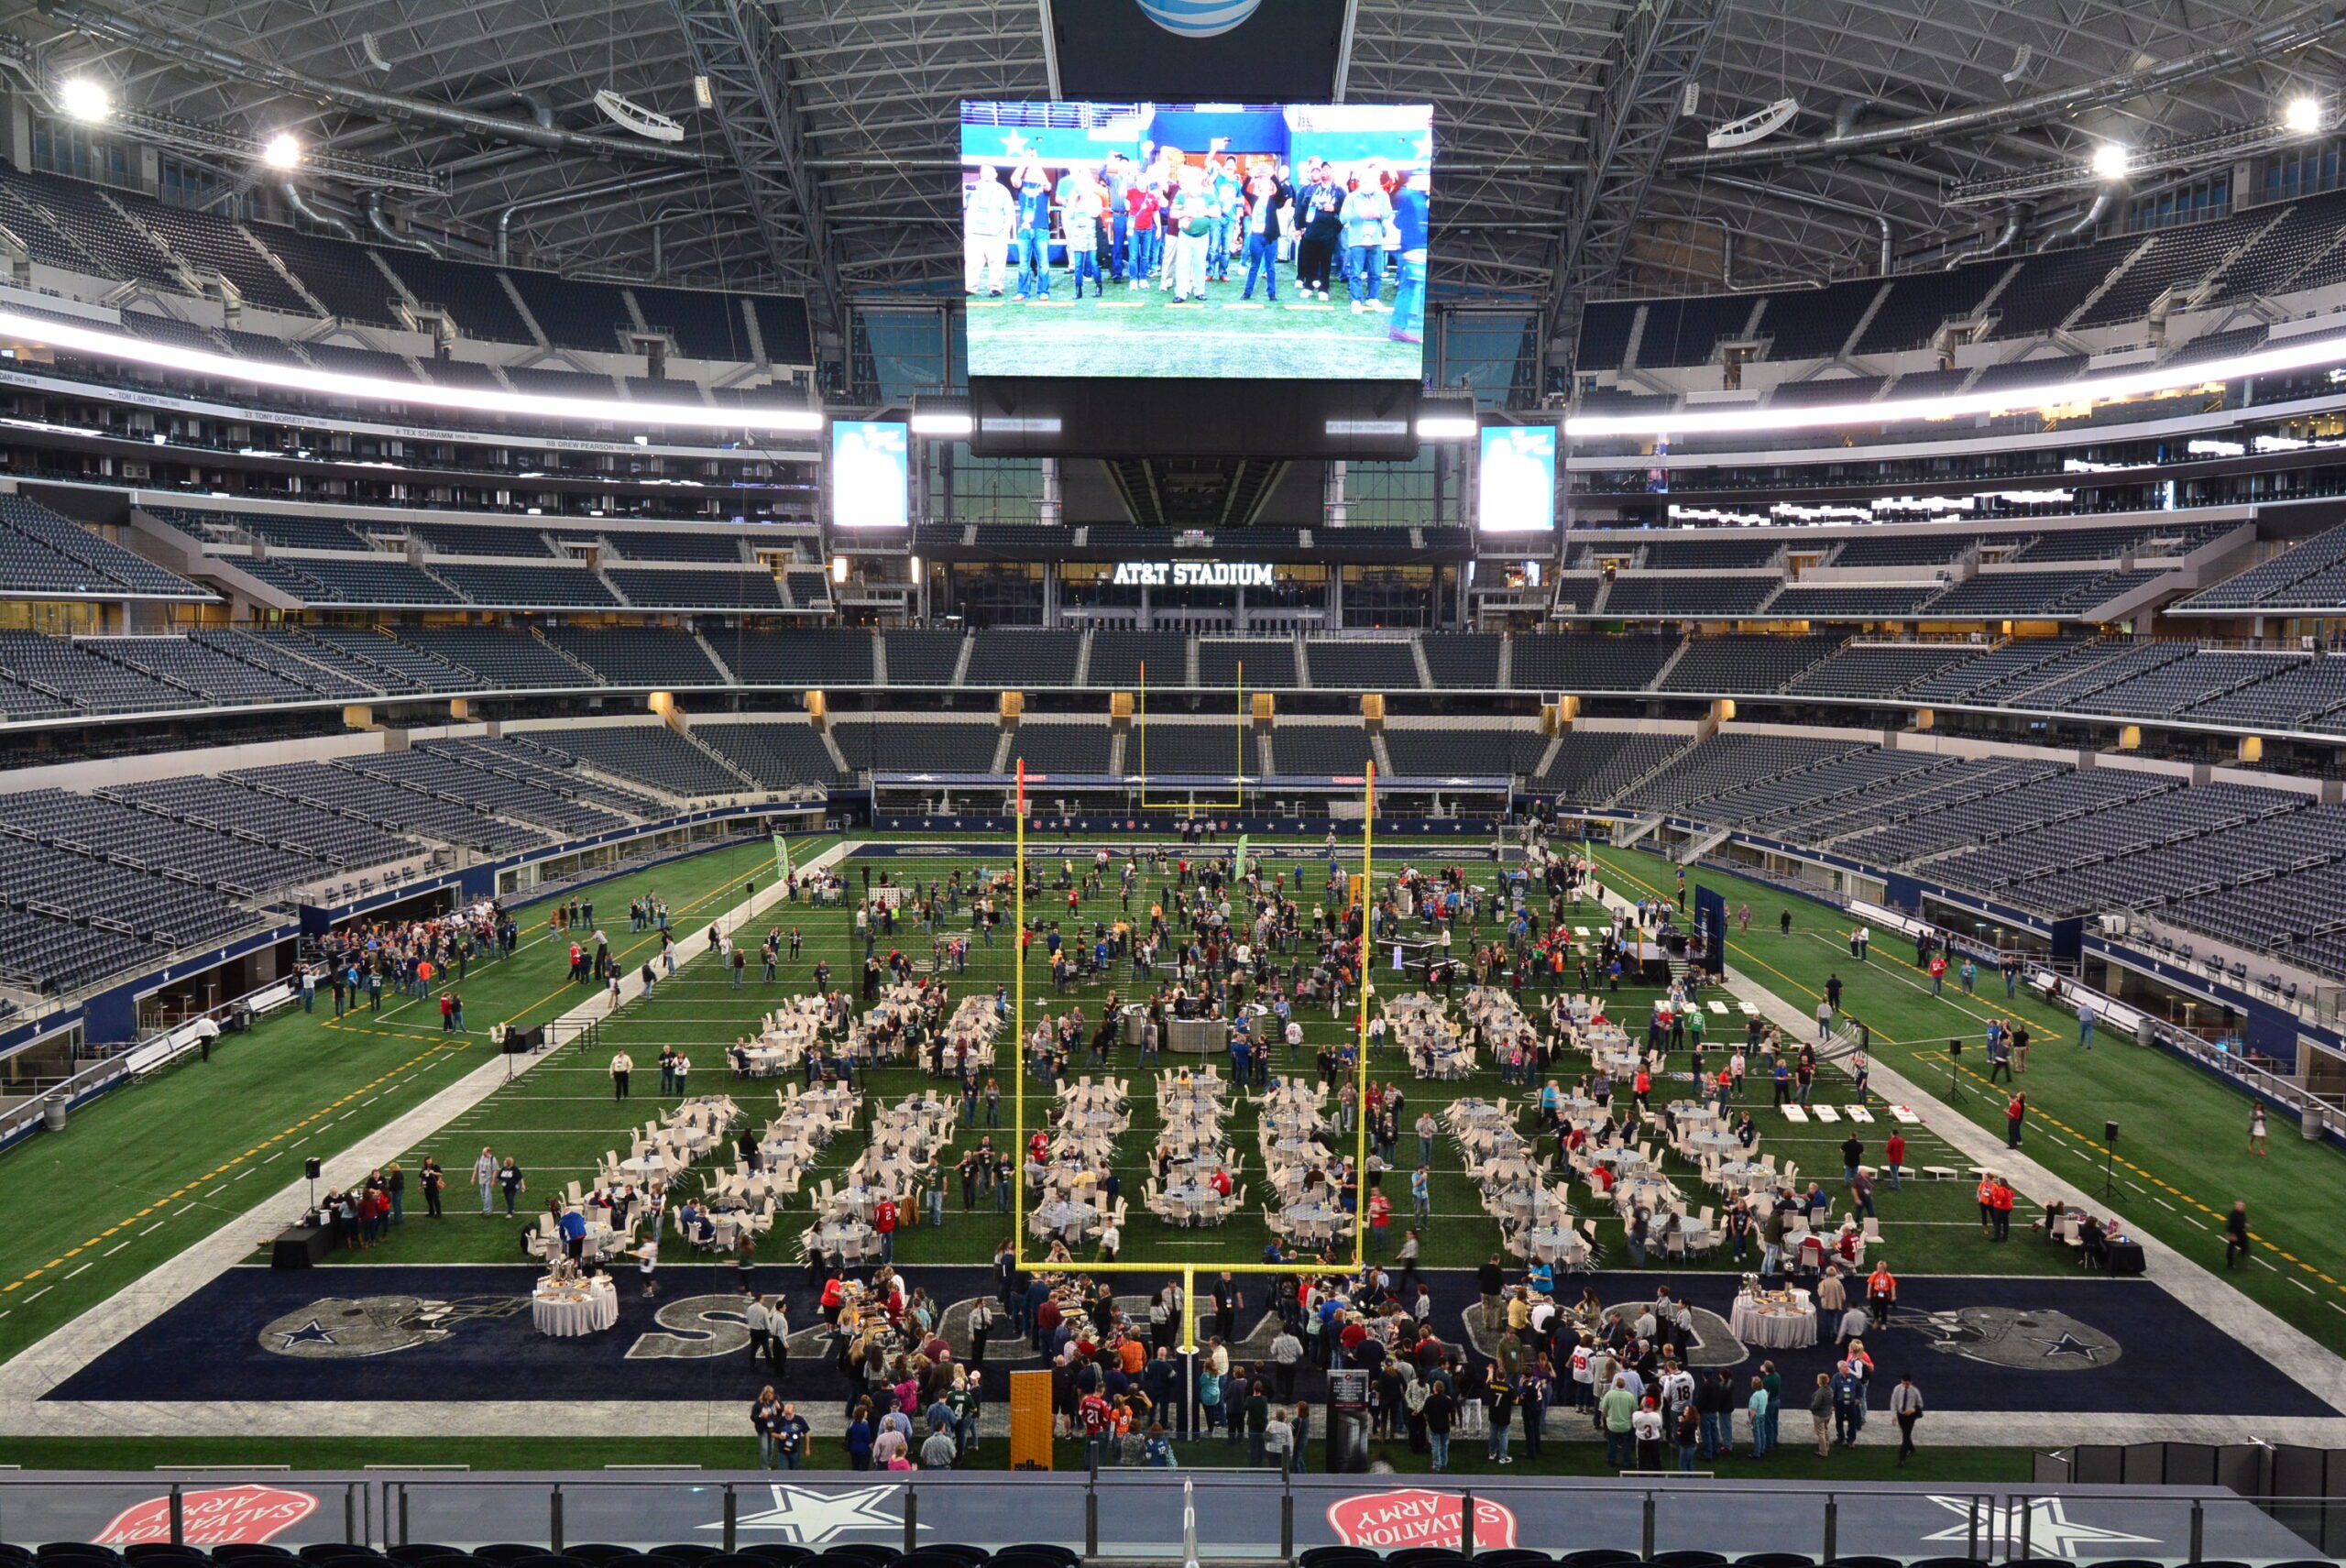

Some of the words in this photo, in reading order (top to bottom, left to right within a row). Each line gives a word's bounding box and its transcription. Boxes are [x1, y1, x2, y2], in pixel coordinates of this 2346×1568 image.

[118, 391, 132, 401] TOM
[133, 394, 158, 404] LANDRY
[244, 411, 252, 419] 33
[255, 412, 273, 421] TONY
[274, 415, 305, 425] DORSETT
[402, 429, 416, 437] TEX
[418, 430, 454, 440] SCHRAMM
[580, 442, 614, 450] PEARSON
[1113, 563, 1169, 585] AT&T
[1173, 563, 1273, 585] STADIUM
[1693, 1015, 1702, 1025] 92
[885, 1211, 892, 1221] 2
[1572, 1354, 1587, 1370] 99
[1495, 1393, 1503, 1407] 7
[1676, 1386, 1691, 1401] 18
[954, 1403, 963, 1420] 4
[1087, 1409, 1100, 1424] 21
[1120, 1415, 1128, 1426] 18
[1644, 1424, 1652, 1439] 3
[1157, 1446, 1167, 1454] 12
[1357, 1496, 1440, 1530] ARMY
[105, 1501, 307, 1544] SALVAION
[1355, 1505, 1501, 1547] SLVATION
[183, 1527, 247, 1544] TH
